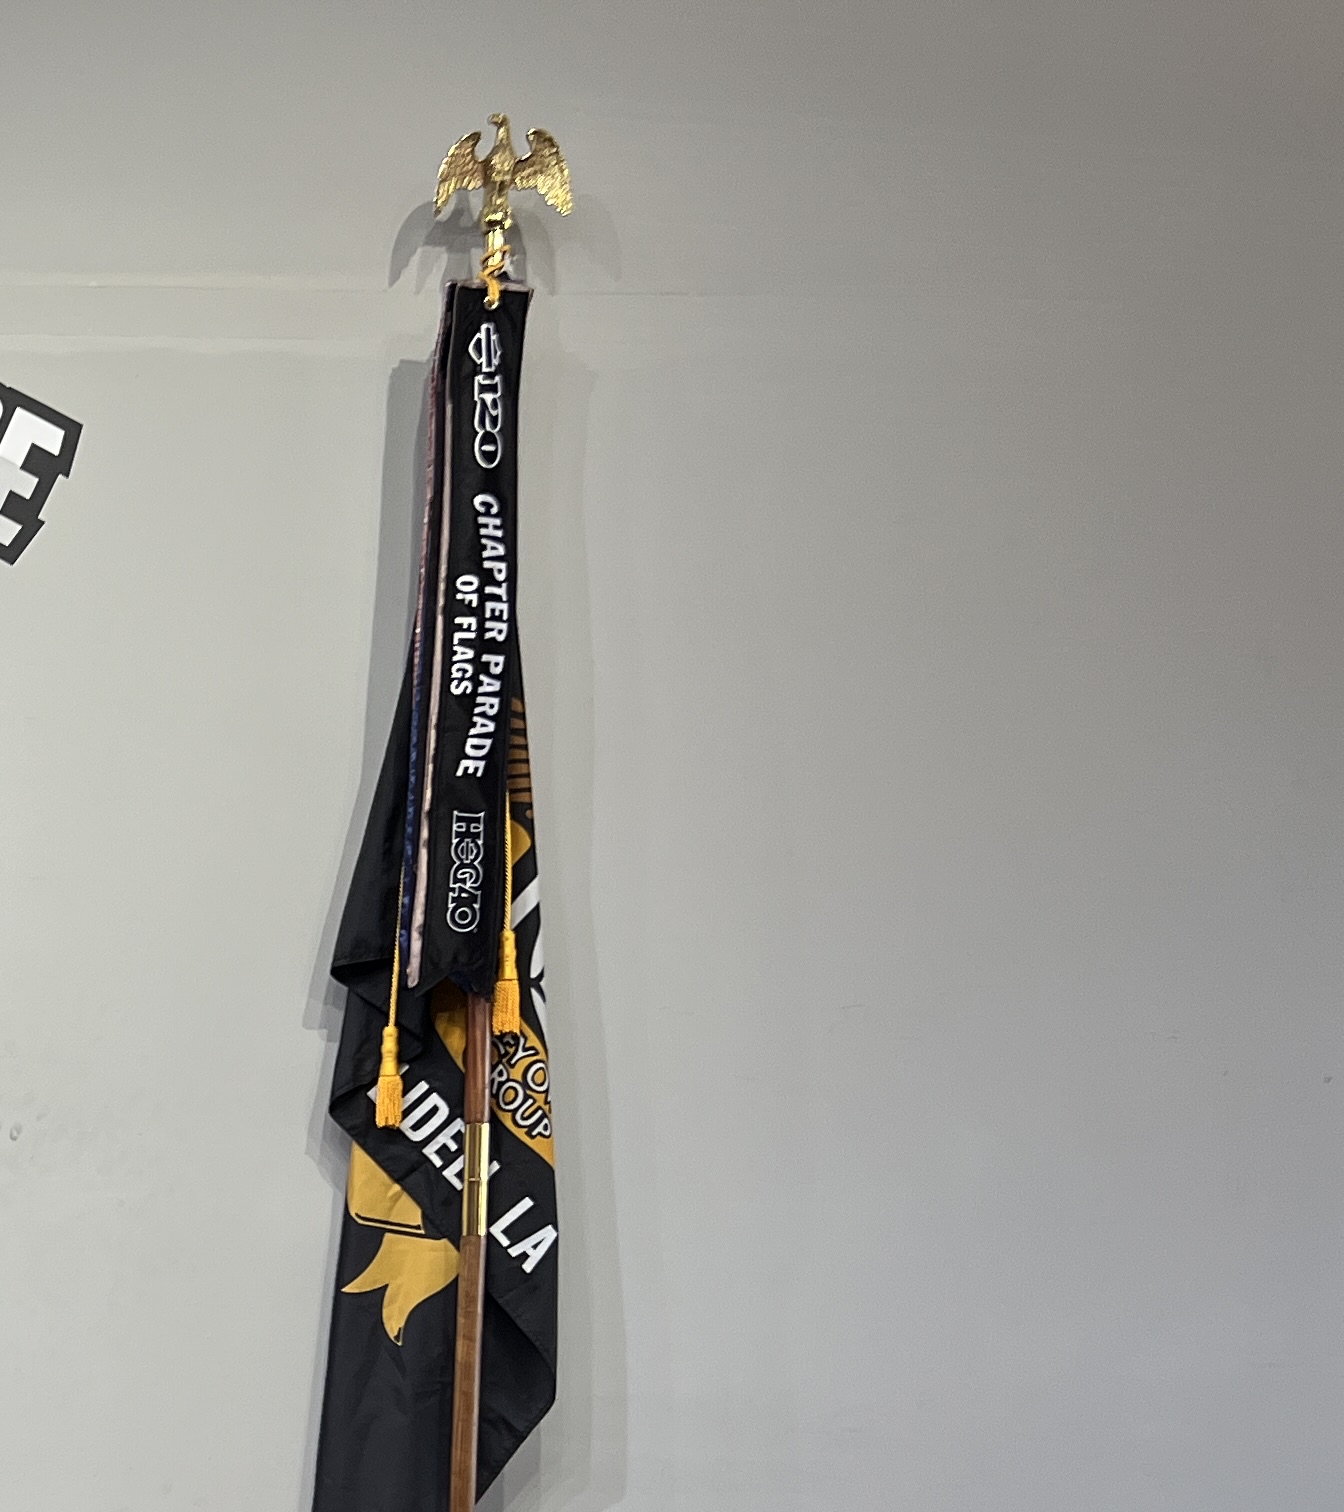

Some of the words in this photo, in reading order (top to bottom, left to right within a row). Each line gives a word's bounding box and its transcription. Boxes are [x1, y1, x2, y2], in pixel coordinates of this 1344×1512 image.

[455, 574, 480, 608] OF
[472, 493, 509, 643] CHAPTER
[449, 616, 479, 696] FLAGS
[454, 654, 506, 778] PARADE
[490, 1063, 552, 1138] ROUP
[488, 1196, 558, 1274] LA
